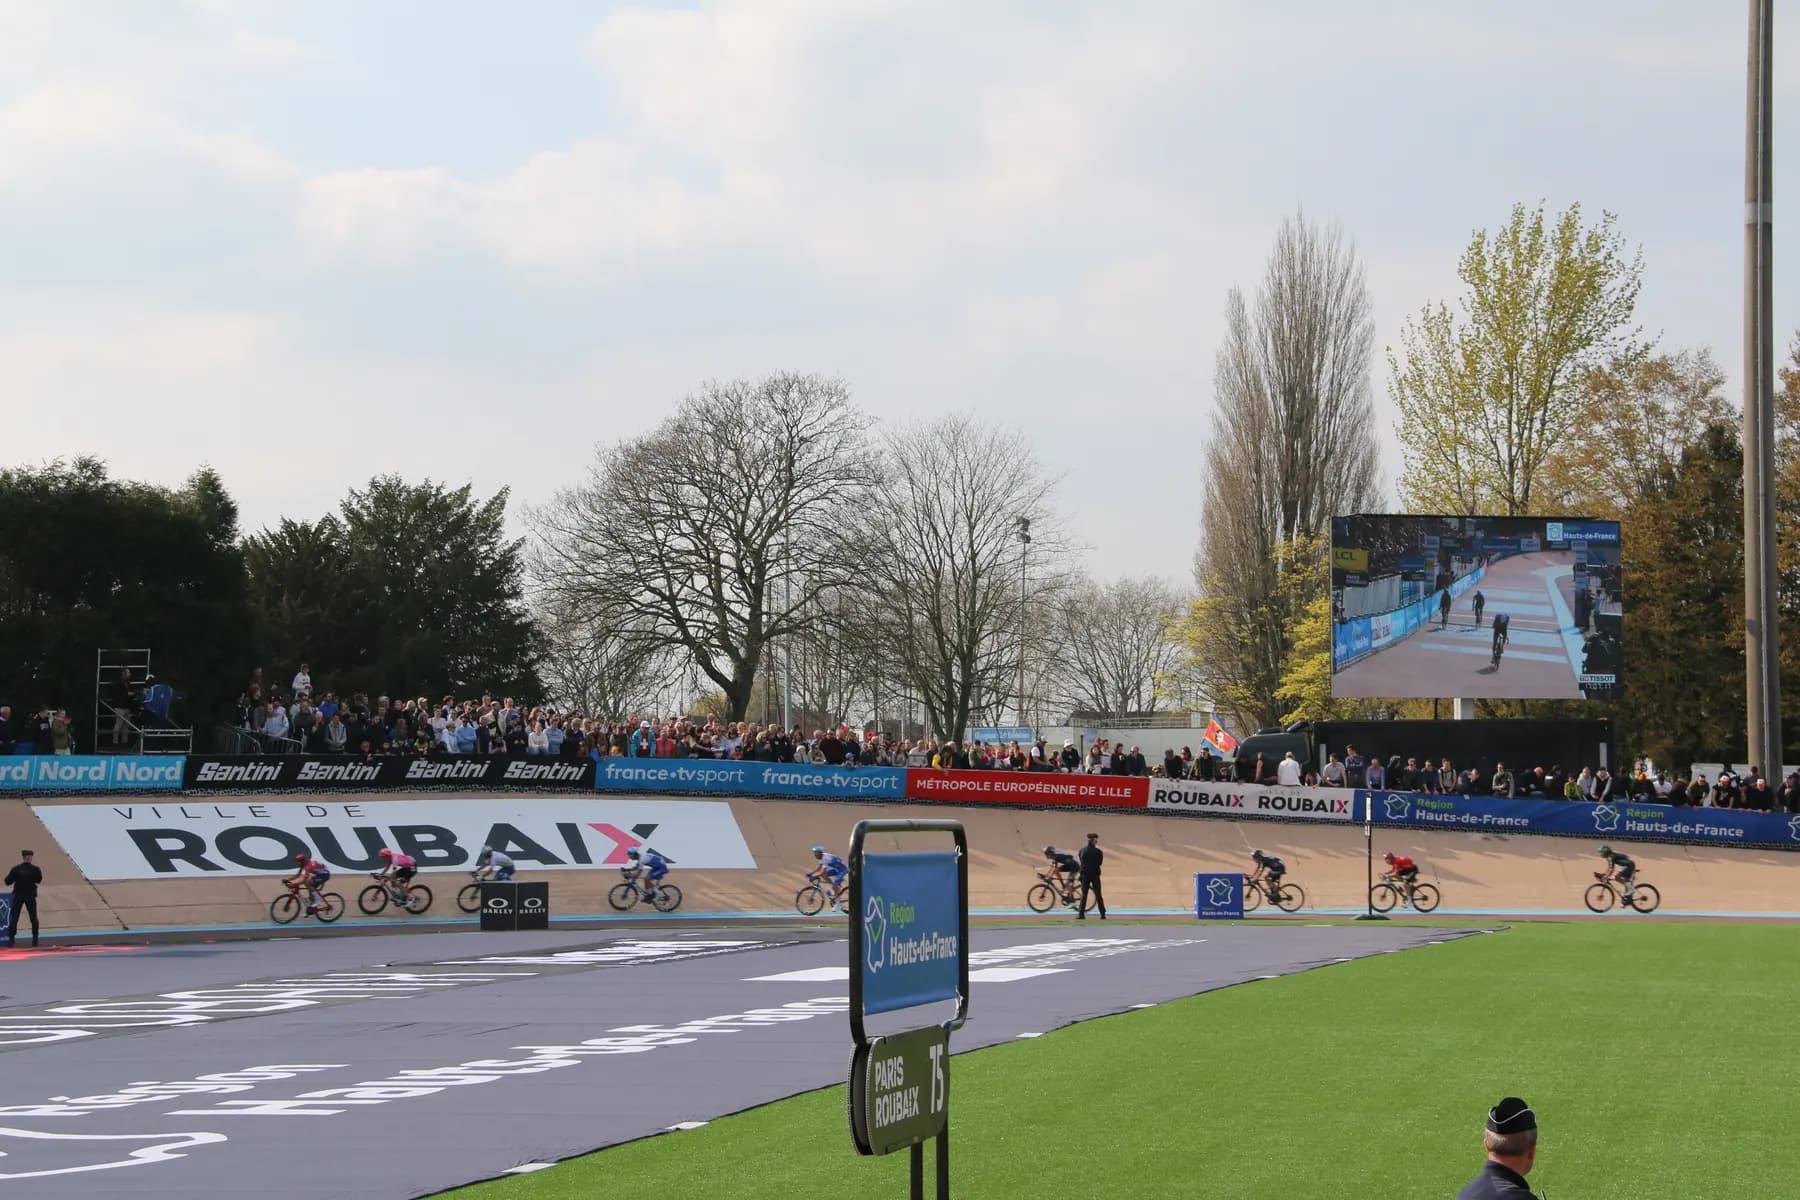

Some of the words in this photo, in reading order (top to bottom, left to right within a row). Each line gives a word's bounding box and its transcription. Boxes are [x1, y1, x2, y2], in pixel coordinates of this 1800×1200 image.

[38, 761, 107, 781] Nord
[116, 761, 182, 781] Nord
[196, 762, 285, 781] Santini
[296, 762, 383, 780] Santini
[405, 760, 491, 779] Santini
[503, 761, 588, 781] Santini
[916, 777, 991, 791] MÉTROPOLE
[994, 780, 1076, 795] EUROPÉENNE
[1079, 786, 1096, 796] DE
[1099, 787, 1132, 797] LILLE
[1155, 789, 1244, 808] ROUBAIX
[1258, 795, 1349, 814] ROUBAIX
[1416, 798, 1454, 810] Région
[113, 806, 271, 819] VILLE
[305, 805, 366, 818] DE
[1415, 809, 1529, 826] Hauts-de-France
[1626, 808, 1664, 819] Région
[1625, 820, 1744, 837] Hauts-de-France
[126, 823, 676, 873] ROUBAIX
[889, 900, 915, 928] Région
[889, 931, 957, 967] Hauts-de-France
[875, 1055, 904, 1091] PARIS
[929, 1044, 944, 1114] 75
[875, 1086, 920, 1128] ROUBAIX
